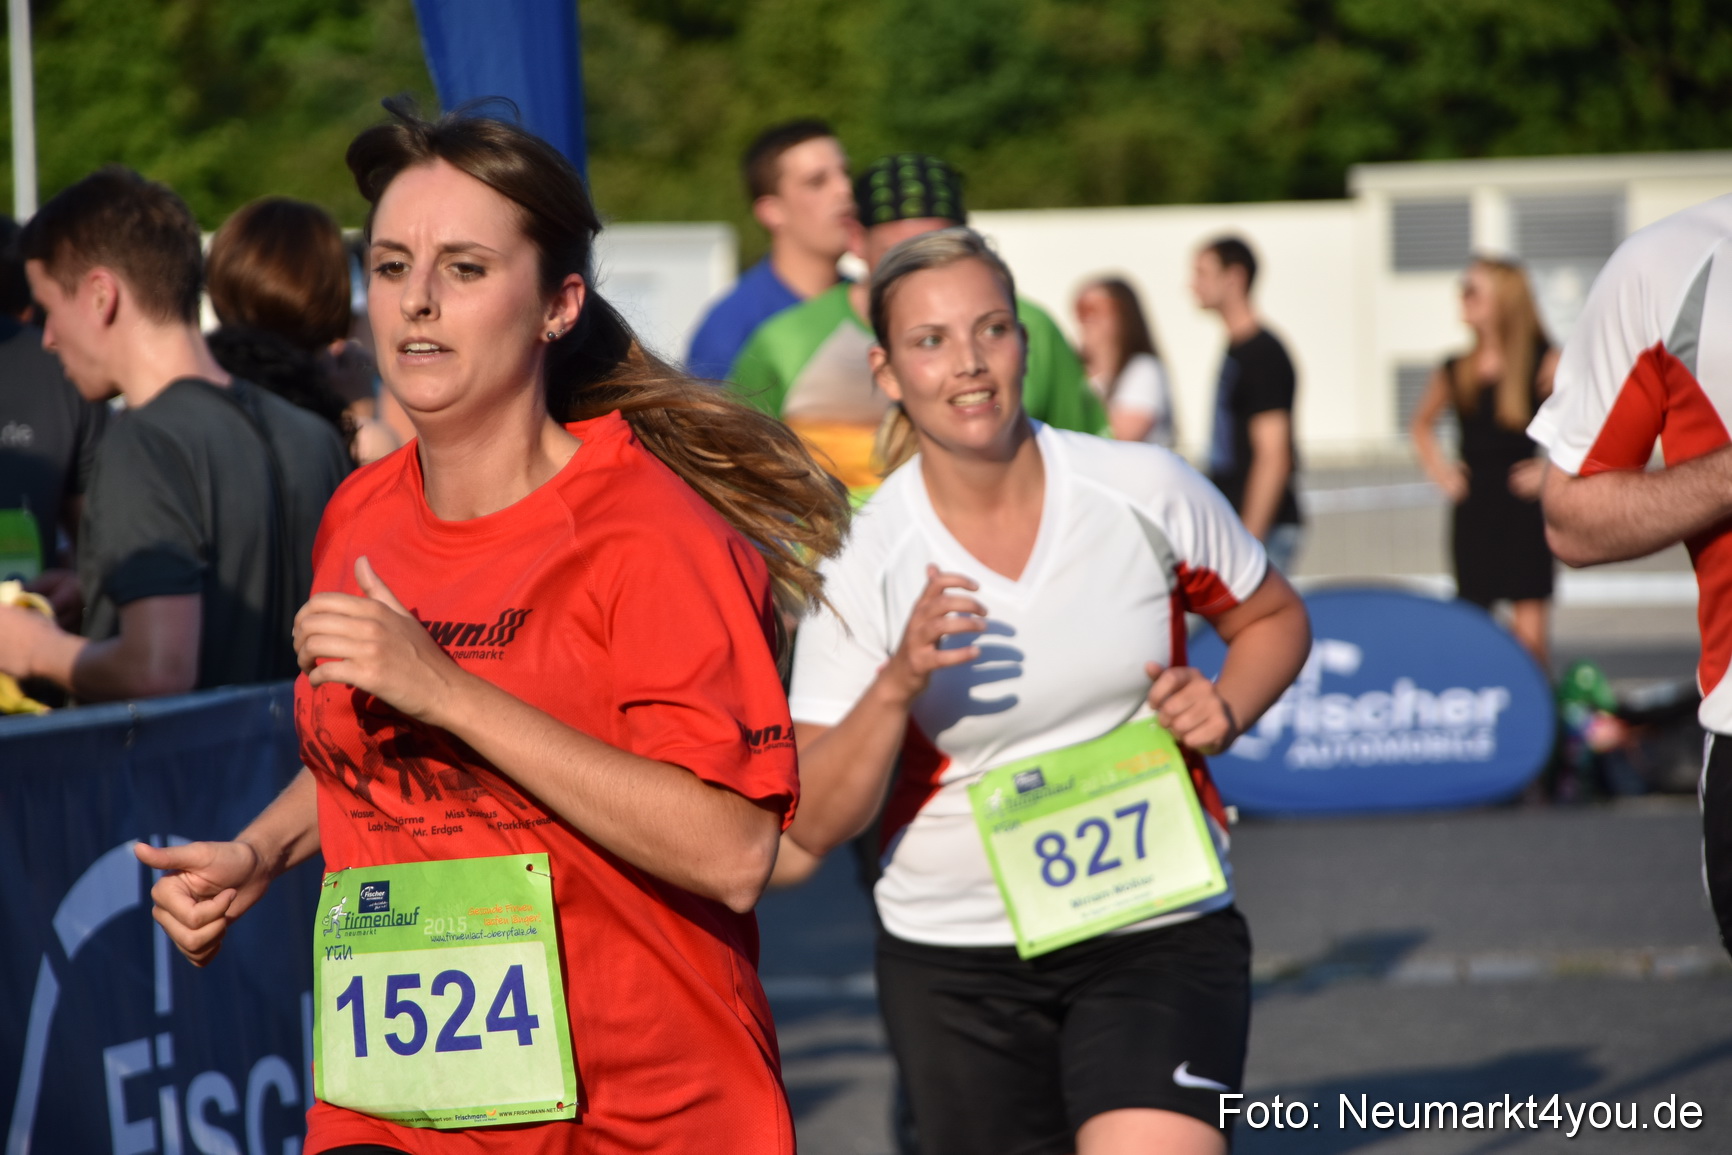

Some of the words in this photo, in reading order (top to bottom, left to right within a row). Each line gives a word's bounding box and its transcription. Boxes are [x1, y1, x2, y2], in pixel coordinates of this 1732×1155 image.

[453, 650, 505, 660] neumarkt
[445, 809, 465, 819] Miss
[413, 828, 428, 837] Mr.
[431, 823, 463, 835] Erdgas
[1034, 800, 1150, 888] 827
[364, 890, 385, 898] Fischer
[468, 904, 503, 916] Gesunde
[505, 903, 533, 913] Firmen
[345, 906, 420, 930] firmenlauf
[424, 916, 468, 935] 2015
[484, 917, 509, 926] laufen
[336, 964, 540, 1058] 1524
[455, 1113, 487, 1121] Frischmann
